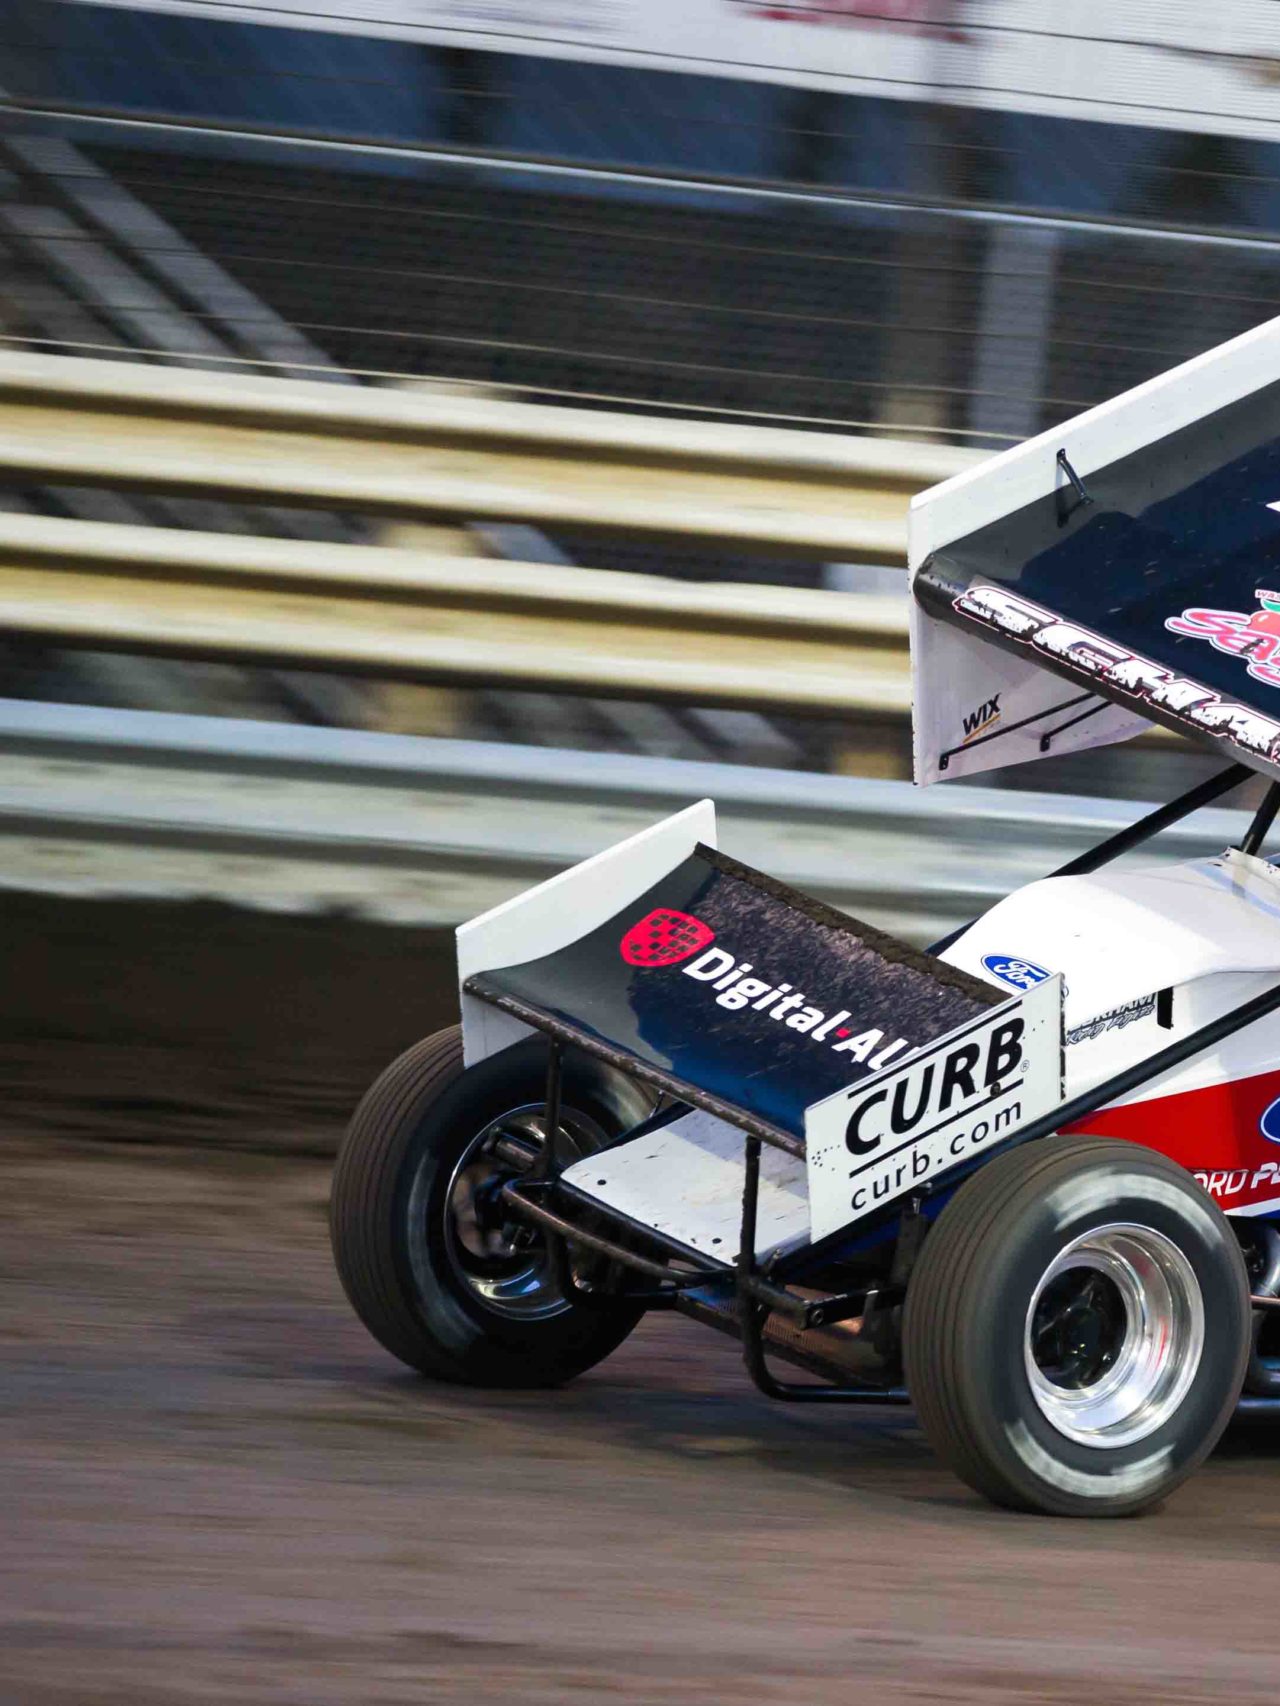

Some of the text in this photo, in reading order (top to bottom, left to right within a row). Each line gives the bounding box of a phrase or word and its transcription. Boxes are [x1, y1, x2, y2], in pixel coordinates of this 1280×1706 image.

[962, 692, 1002, 735] WIX
[845, 1017, 1026, 1156] CURB
[850, 1101, 1022, 1211] curb.com
[1193, 1168, 1249, 1198] ORD
